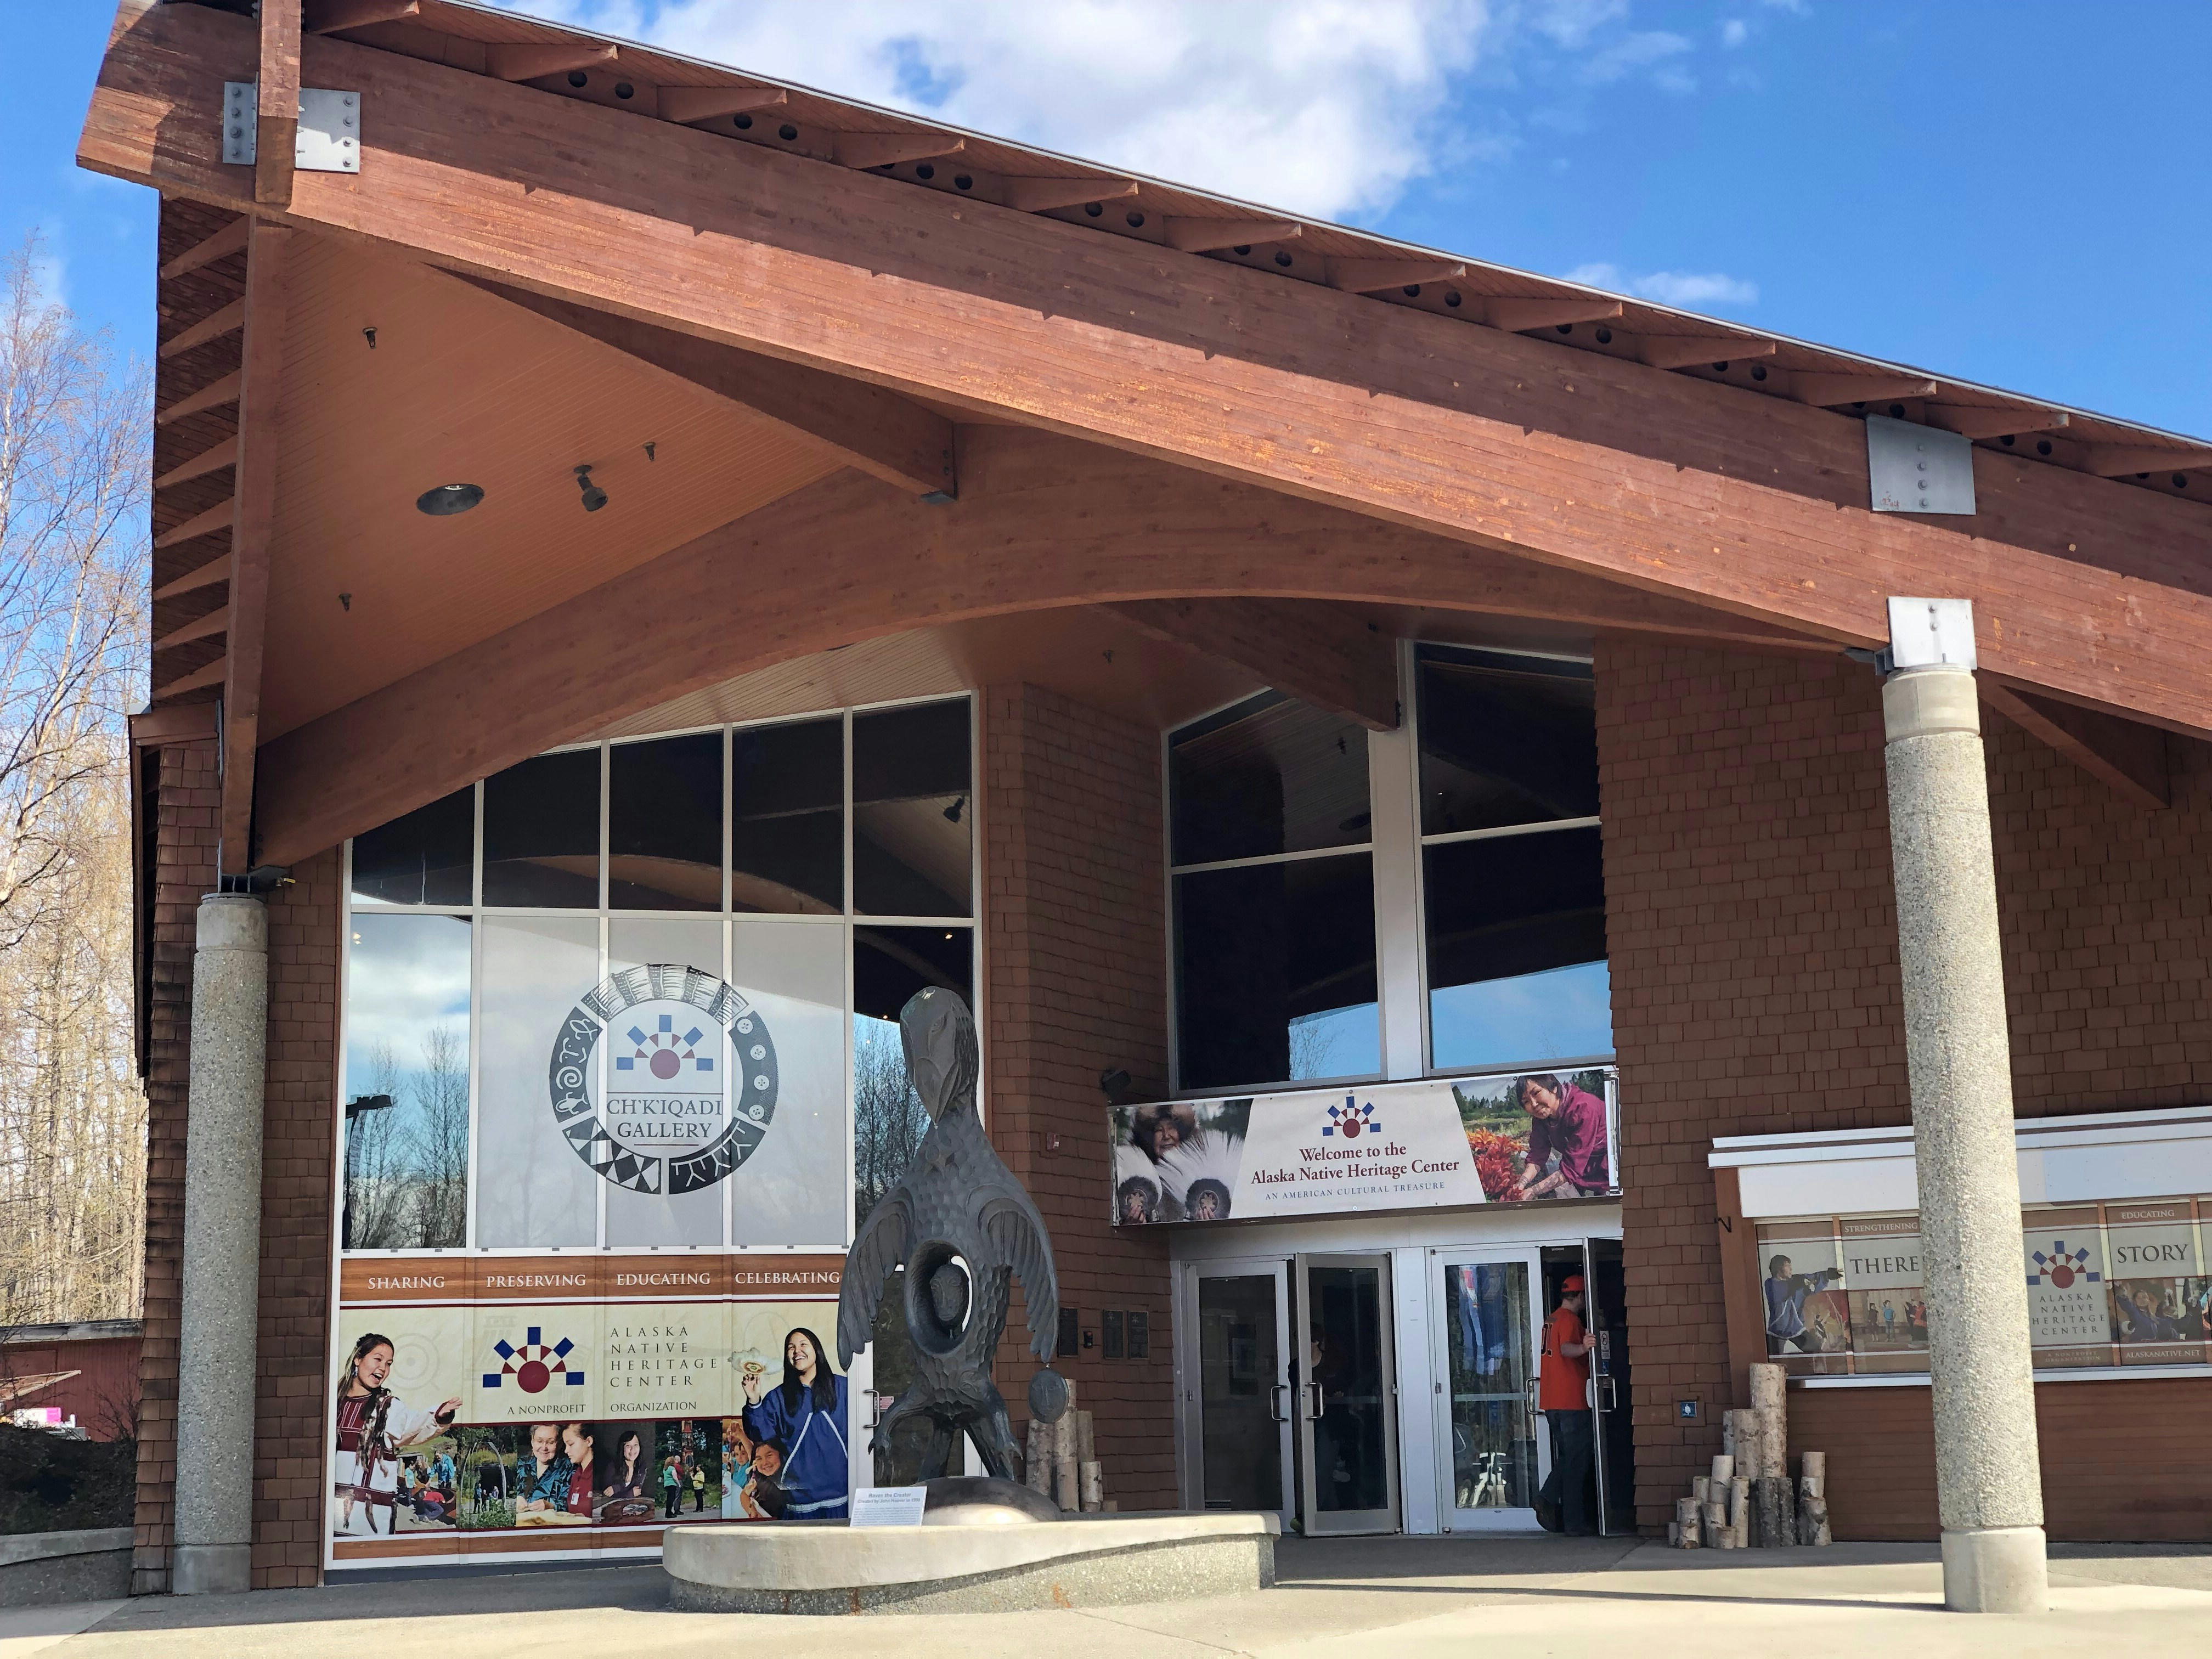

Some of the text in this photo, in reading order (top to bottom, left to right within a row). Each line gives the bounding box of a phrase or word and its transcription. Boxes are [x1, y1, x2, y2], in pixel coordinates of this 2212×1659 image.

[617, 1122, 712, 1138] GALLERY
[1299, 1142, 1407, 1162] Welcome to the
[1251, 1159, 1459, 1184] Alaska Native Heritage Center
[1282, 1189, 1333, 1199] AMERICAN
[1337, 1186, 1389, 1195] CULTURAL
[1393, 1182, 1445, 1192] TREASURE
[2121, 1210, 2175, 1219] EDUCATING
[1844, 1222, 1918, 1233] STRENGTHENING
[2117, 1244, 2189, 1263] STORY
[368, 1276, 445, 1290] SHARING
[486, 1274, 586, 1288] PRESERVING
[616, 1273, 711, 1286] EDUCATING
[735, 1272, 840, 1285] CELEBRATING
[2040, 1293, 2093, 1303] ALASKA
[2041, 1304, 2094, 1313] NATIVE
[2032, 1314, 2106, 1325] HERITAGE
[610, 1327, 689, 1338] ALASKA
[2041, 1326, 2098, 1335] CENTER
[611, 1342, 687, 1354] NATIVE
[2125, 1350, 2200, 1358] ALASKANATIVE.NET
[611, 1358, 717, 1370] HERITAGE
[610, 1375, 693, 1387] CENTER
[507, 1401, 697, 1415] A NONPROFIT ORGANIZATION
